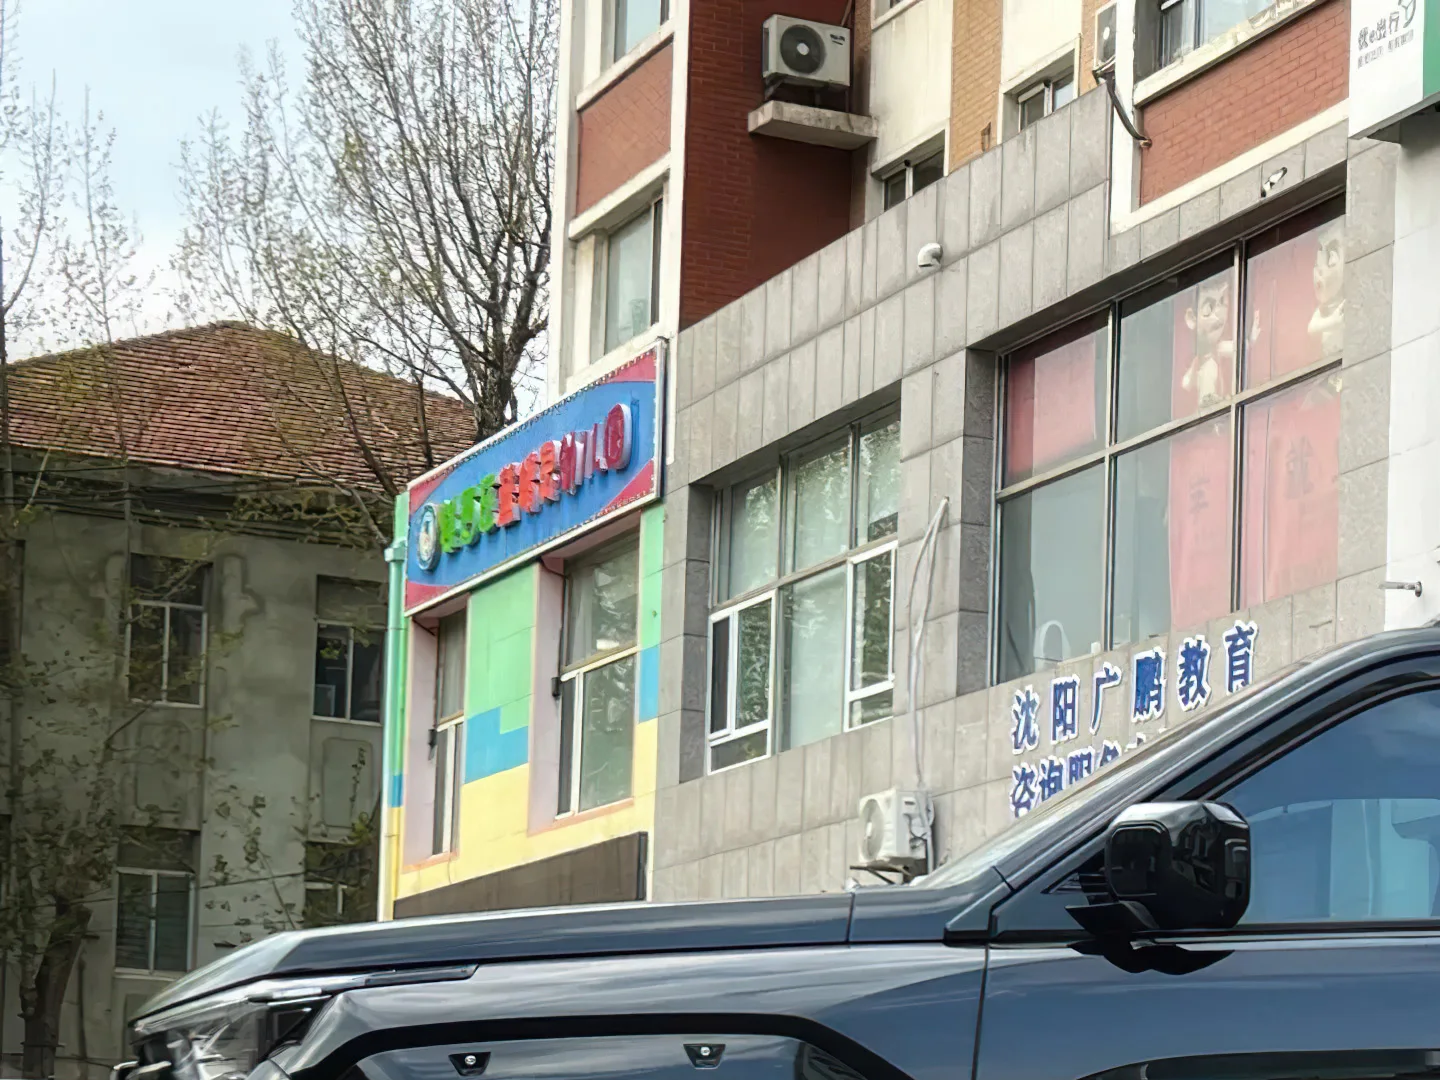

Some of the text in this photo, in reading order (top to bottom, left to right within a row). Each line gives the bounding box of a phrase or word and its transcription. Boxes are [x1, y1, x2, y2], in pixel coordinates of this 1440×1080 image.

[1010, 620, 1258, 755] 沈阳广鹏教育
